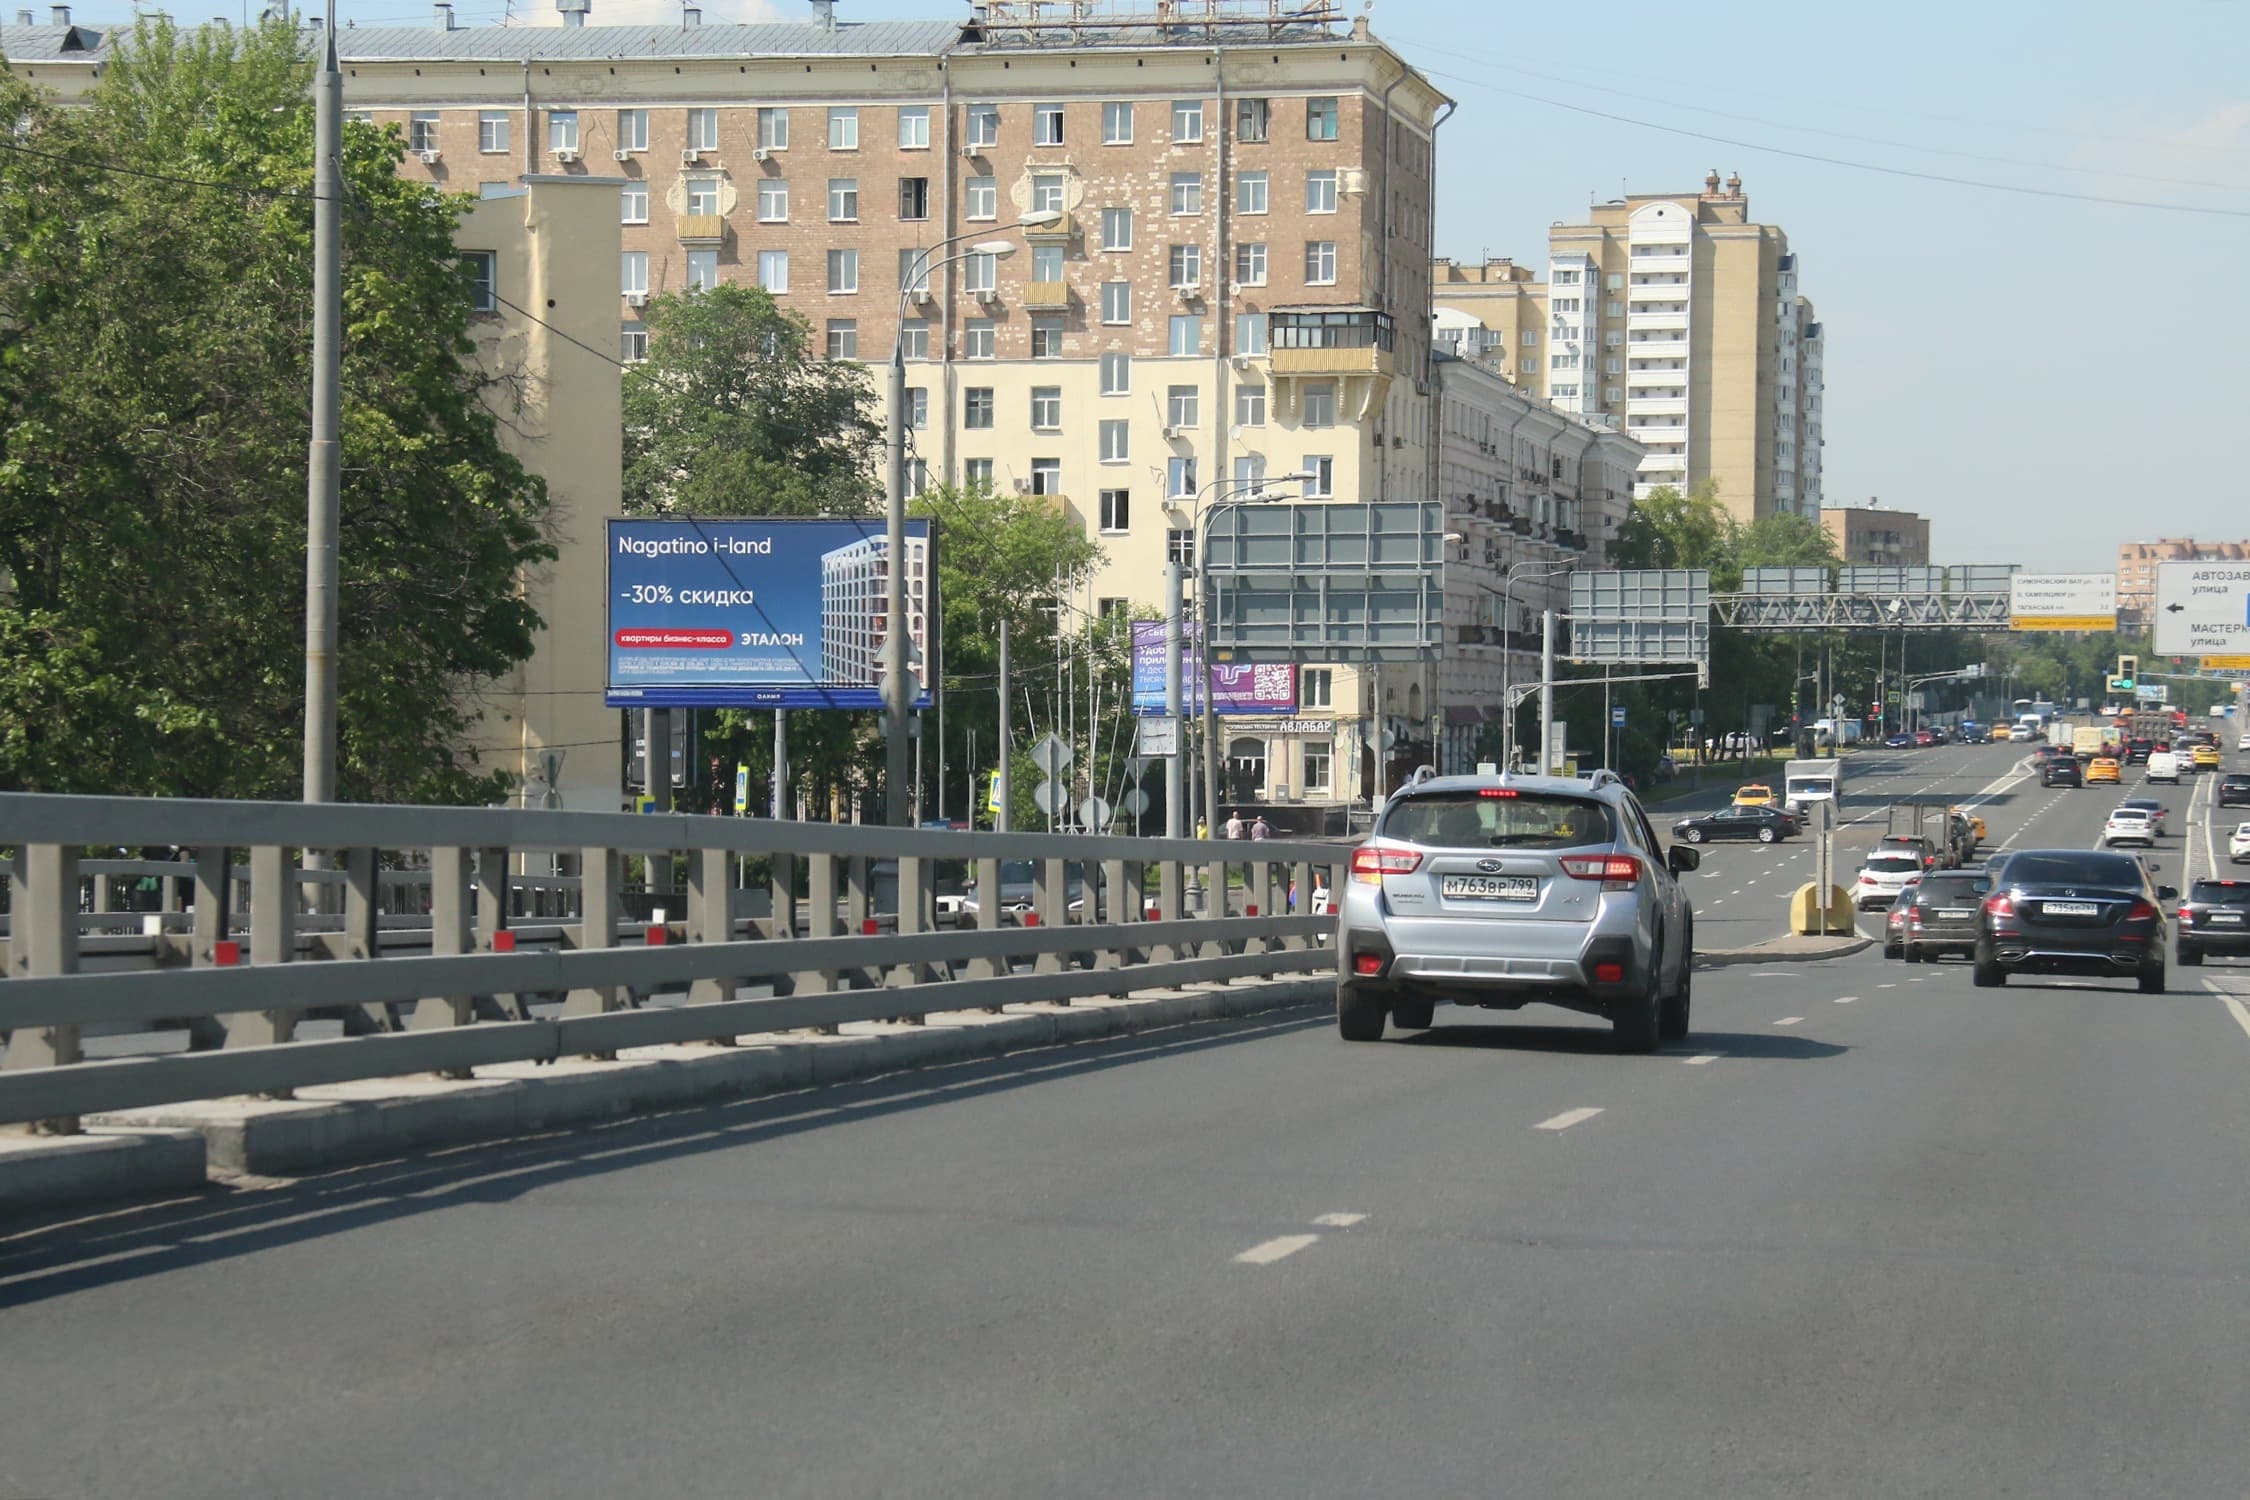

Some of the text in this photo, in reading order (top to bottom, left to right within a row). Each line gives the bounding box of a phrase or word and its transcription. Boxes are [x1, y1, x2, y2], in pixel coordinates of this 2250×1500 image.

[618, 536, 772, 558] Nagatino i-land
[621, 585, 754, 608] -30% скидка
[2192, 585, 2228, 596] улица
[2191, 623, 2250, 634] МАСТЕРК
[621, 633, 727, 644] квартиры бизнес-класса
[741, 633, 803, 646] ЭТАЛОН
[2190, 637, 2226, 648] улица
[1445, 877, 1533, 894] М763ВР 799
